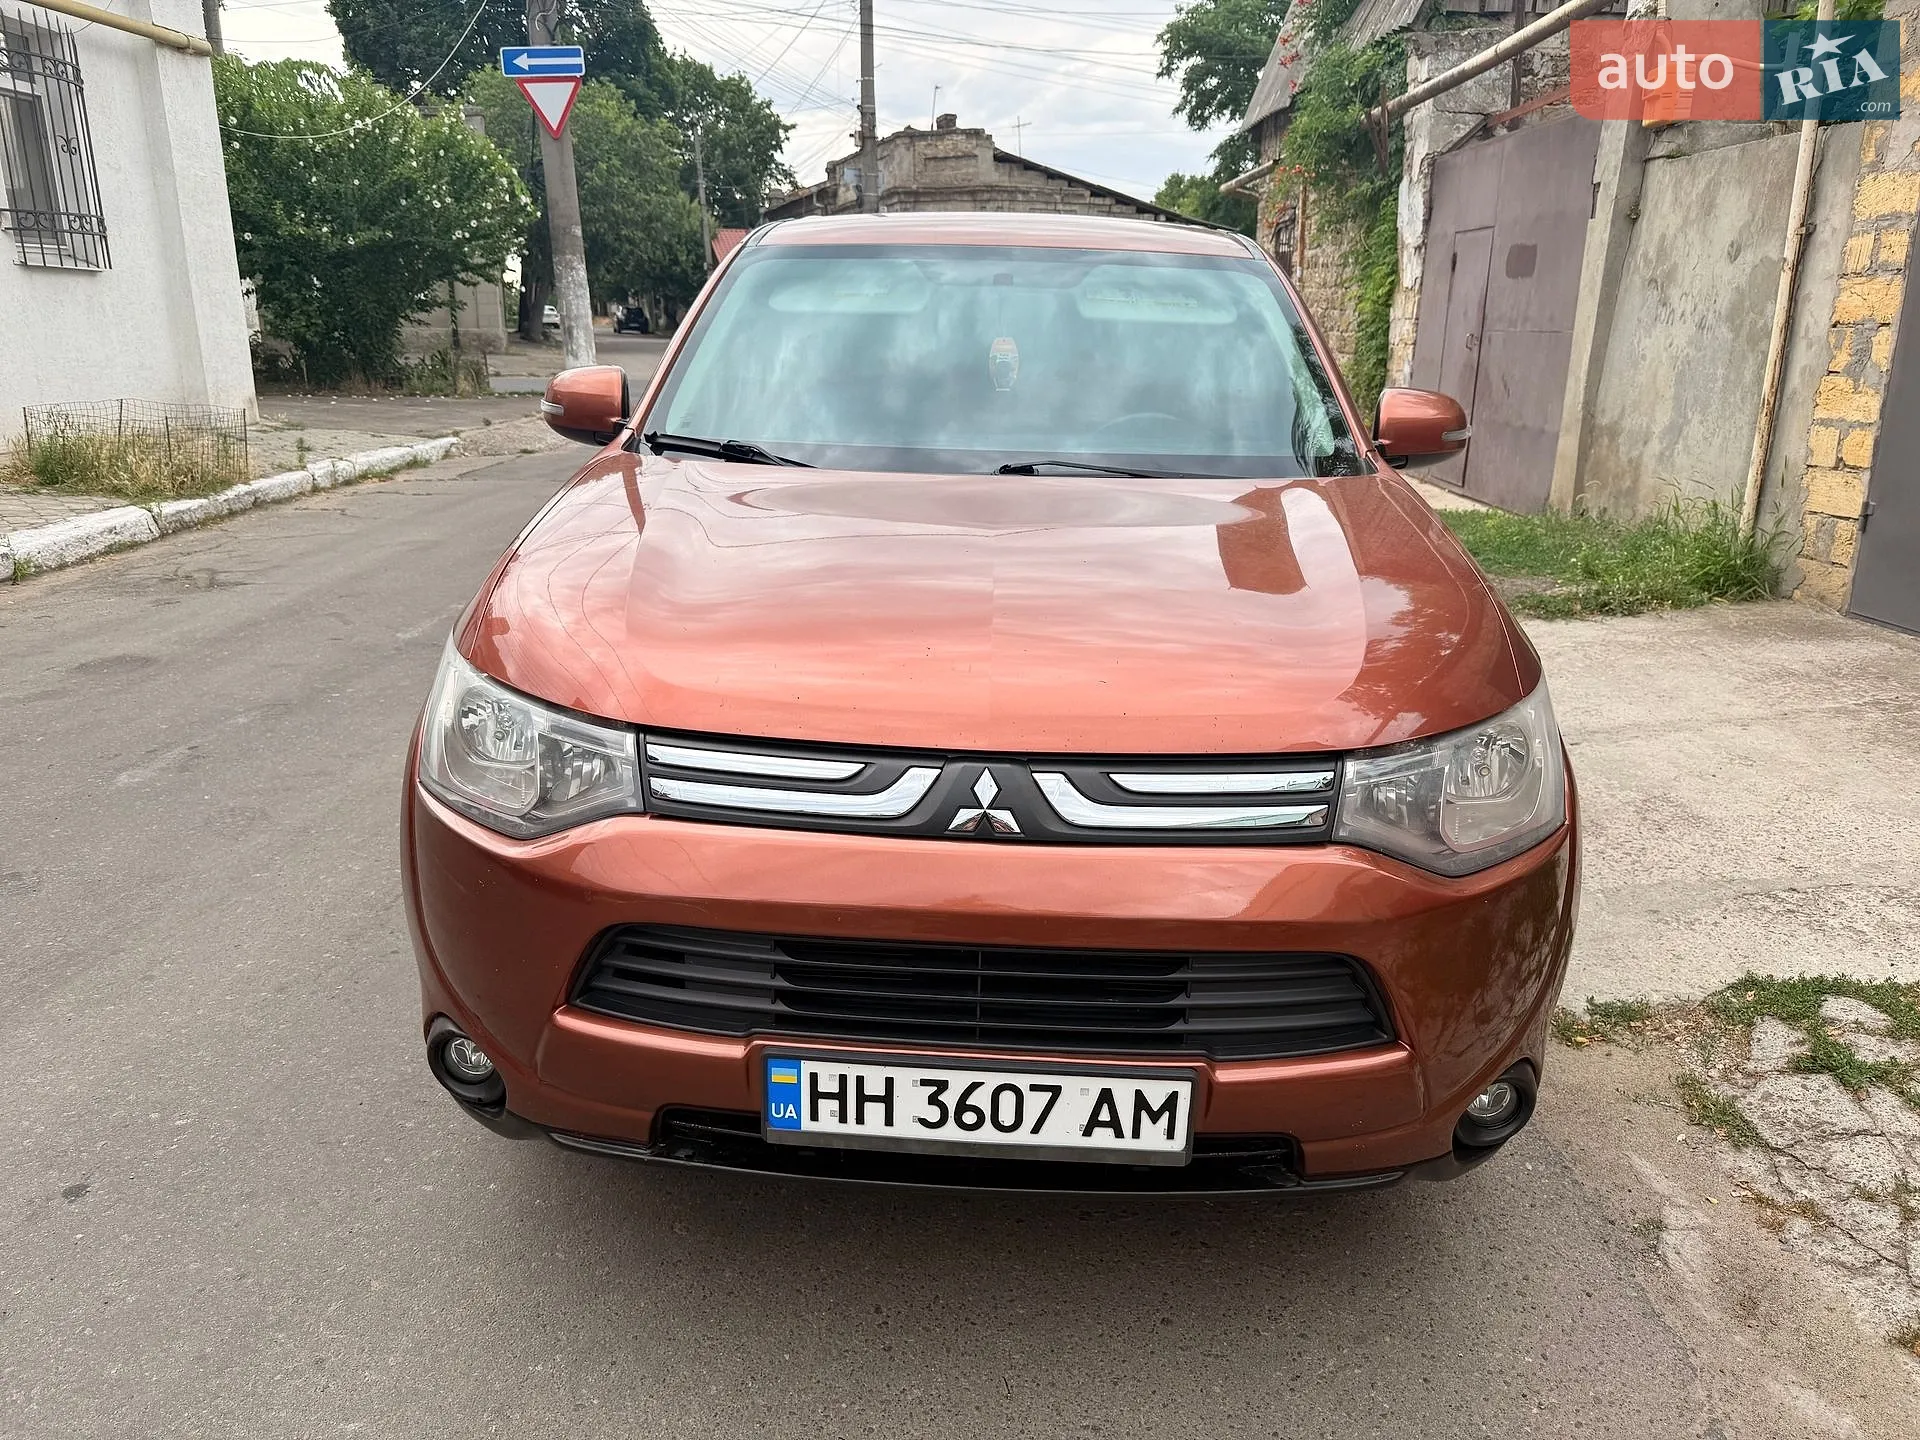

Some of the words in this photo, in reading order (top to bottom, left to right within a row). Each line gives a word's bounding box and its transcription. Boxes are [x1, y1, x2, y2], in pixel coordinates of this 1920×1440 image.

[771, 1102, 798, 1119] UA
[809, 1071, 895, 1127] HH
[917, 1078, 1063, 1134] 3607
[1082, 1087, 1179, 1140] AM
